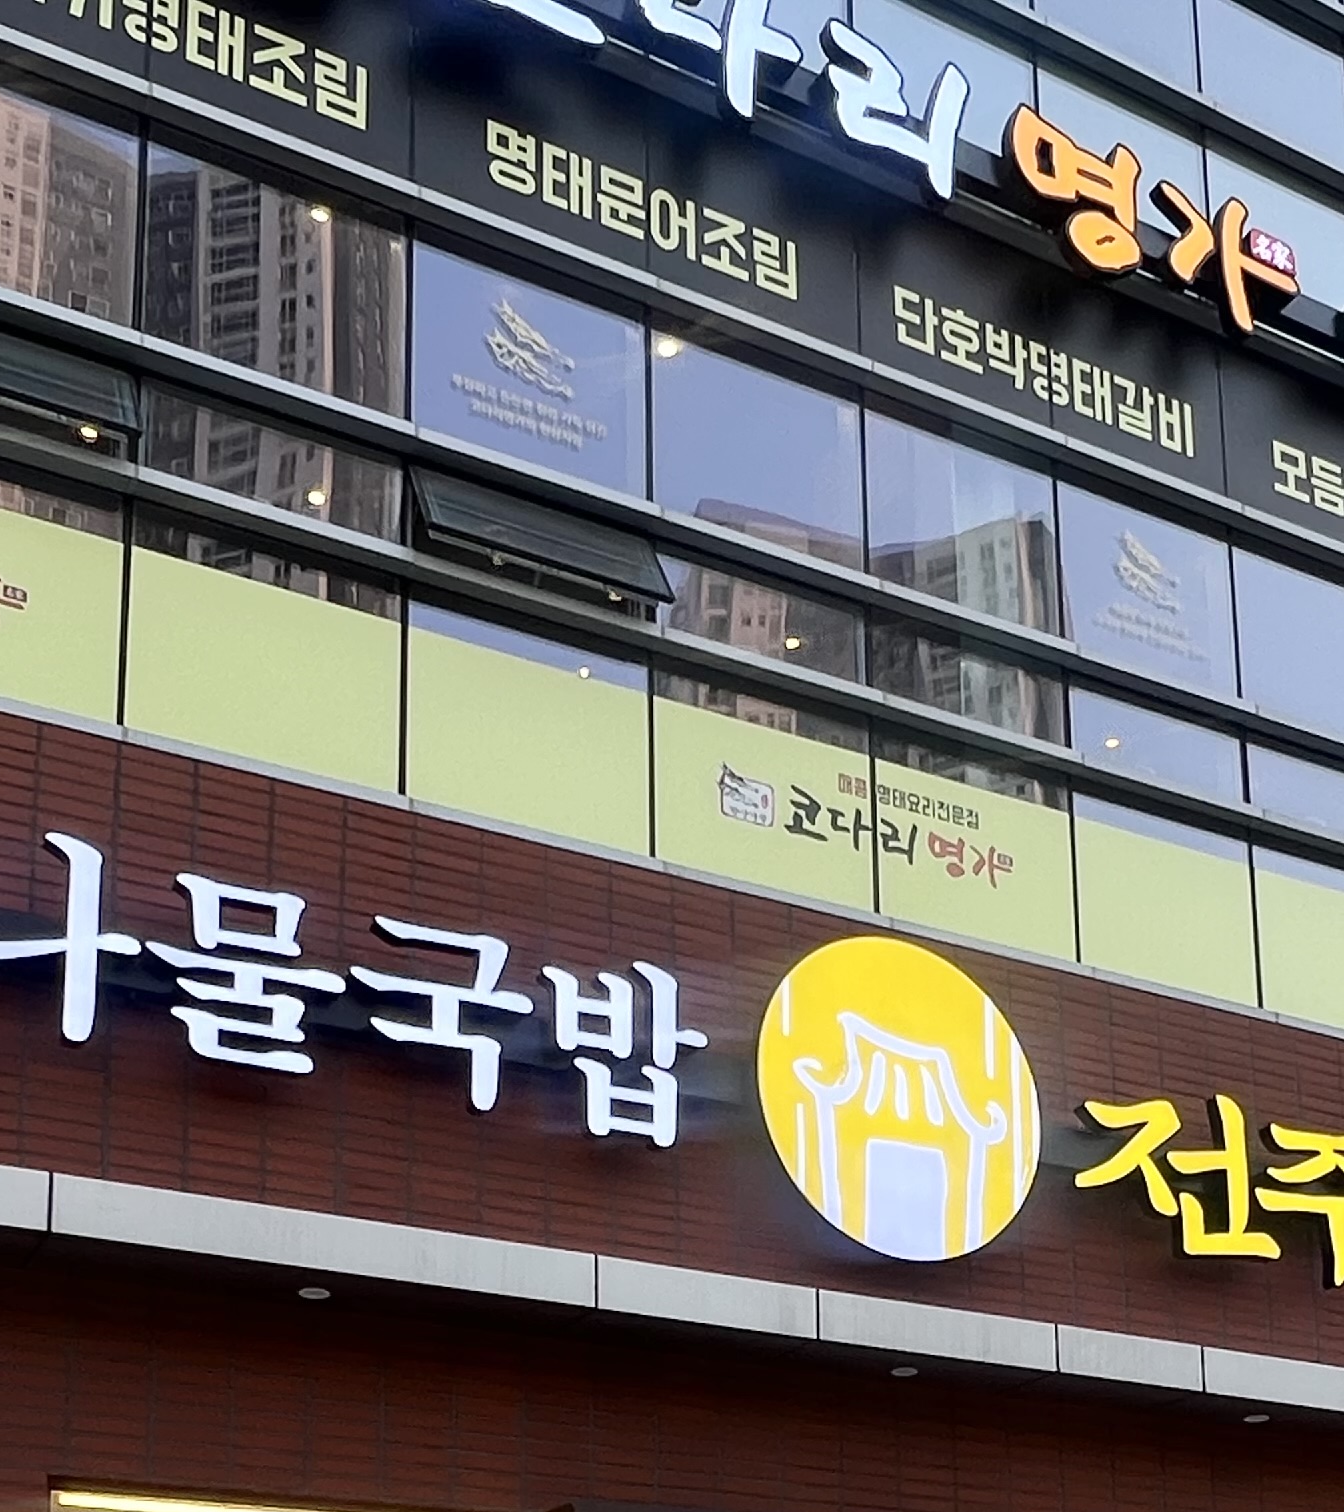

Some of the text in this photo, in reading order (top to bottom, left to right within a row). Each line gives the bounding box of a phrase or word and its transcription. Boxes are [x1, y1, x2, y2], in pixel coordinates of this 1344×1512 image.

[485, 118, 799, 301] 명태문어조림
[486, 0, 1300, 332] 다리 명가
[892, 284, 1195, 459] 단호박명태갈비
[784, 784, 1014, 889] 코다리 명가
